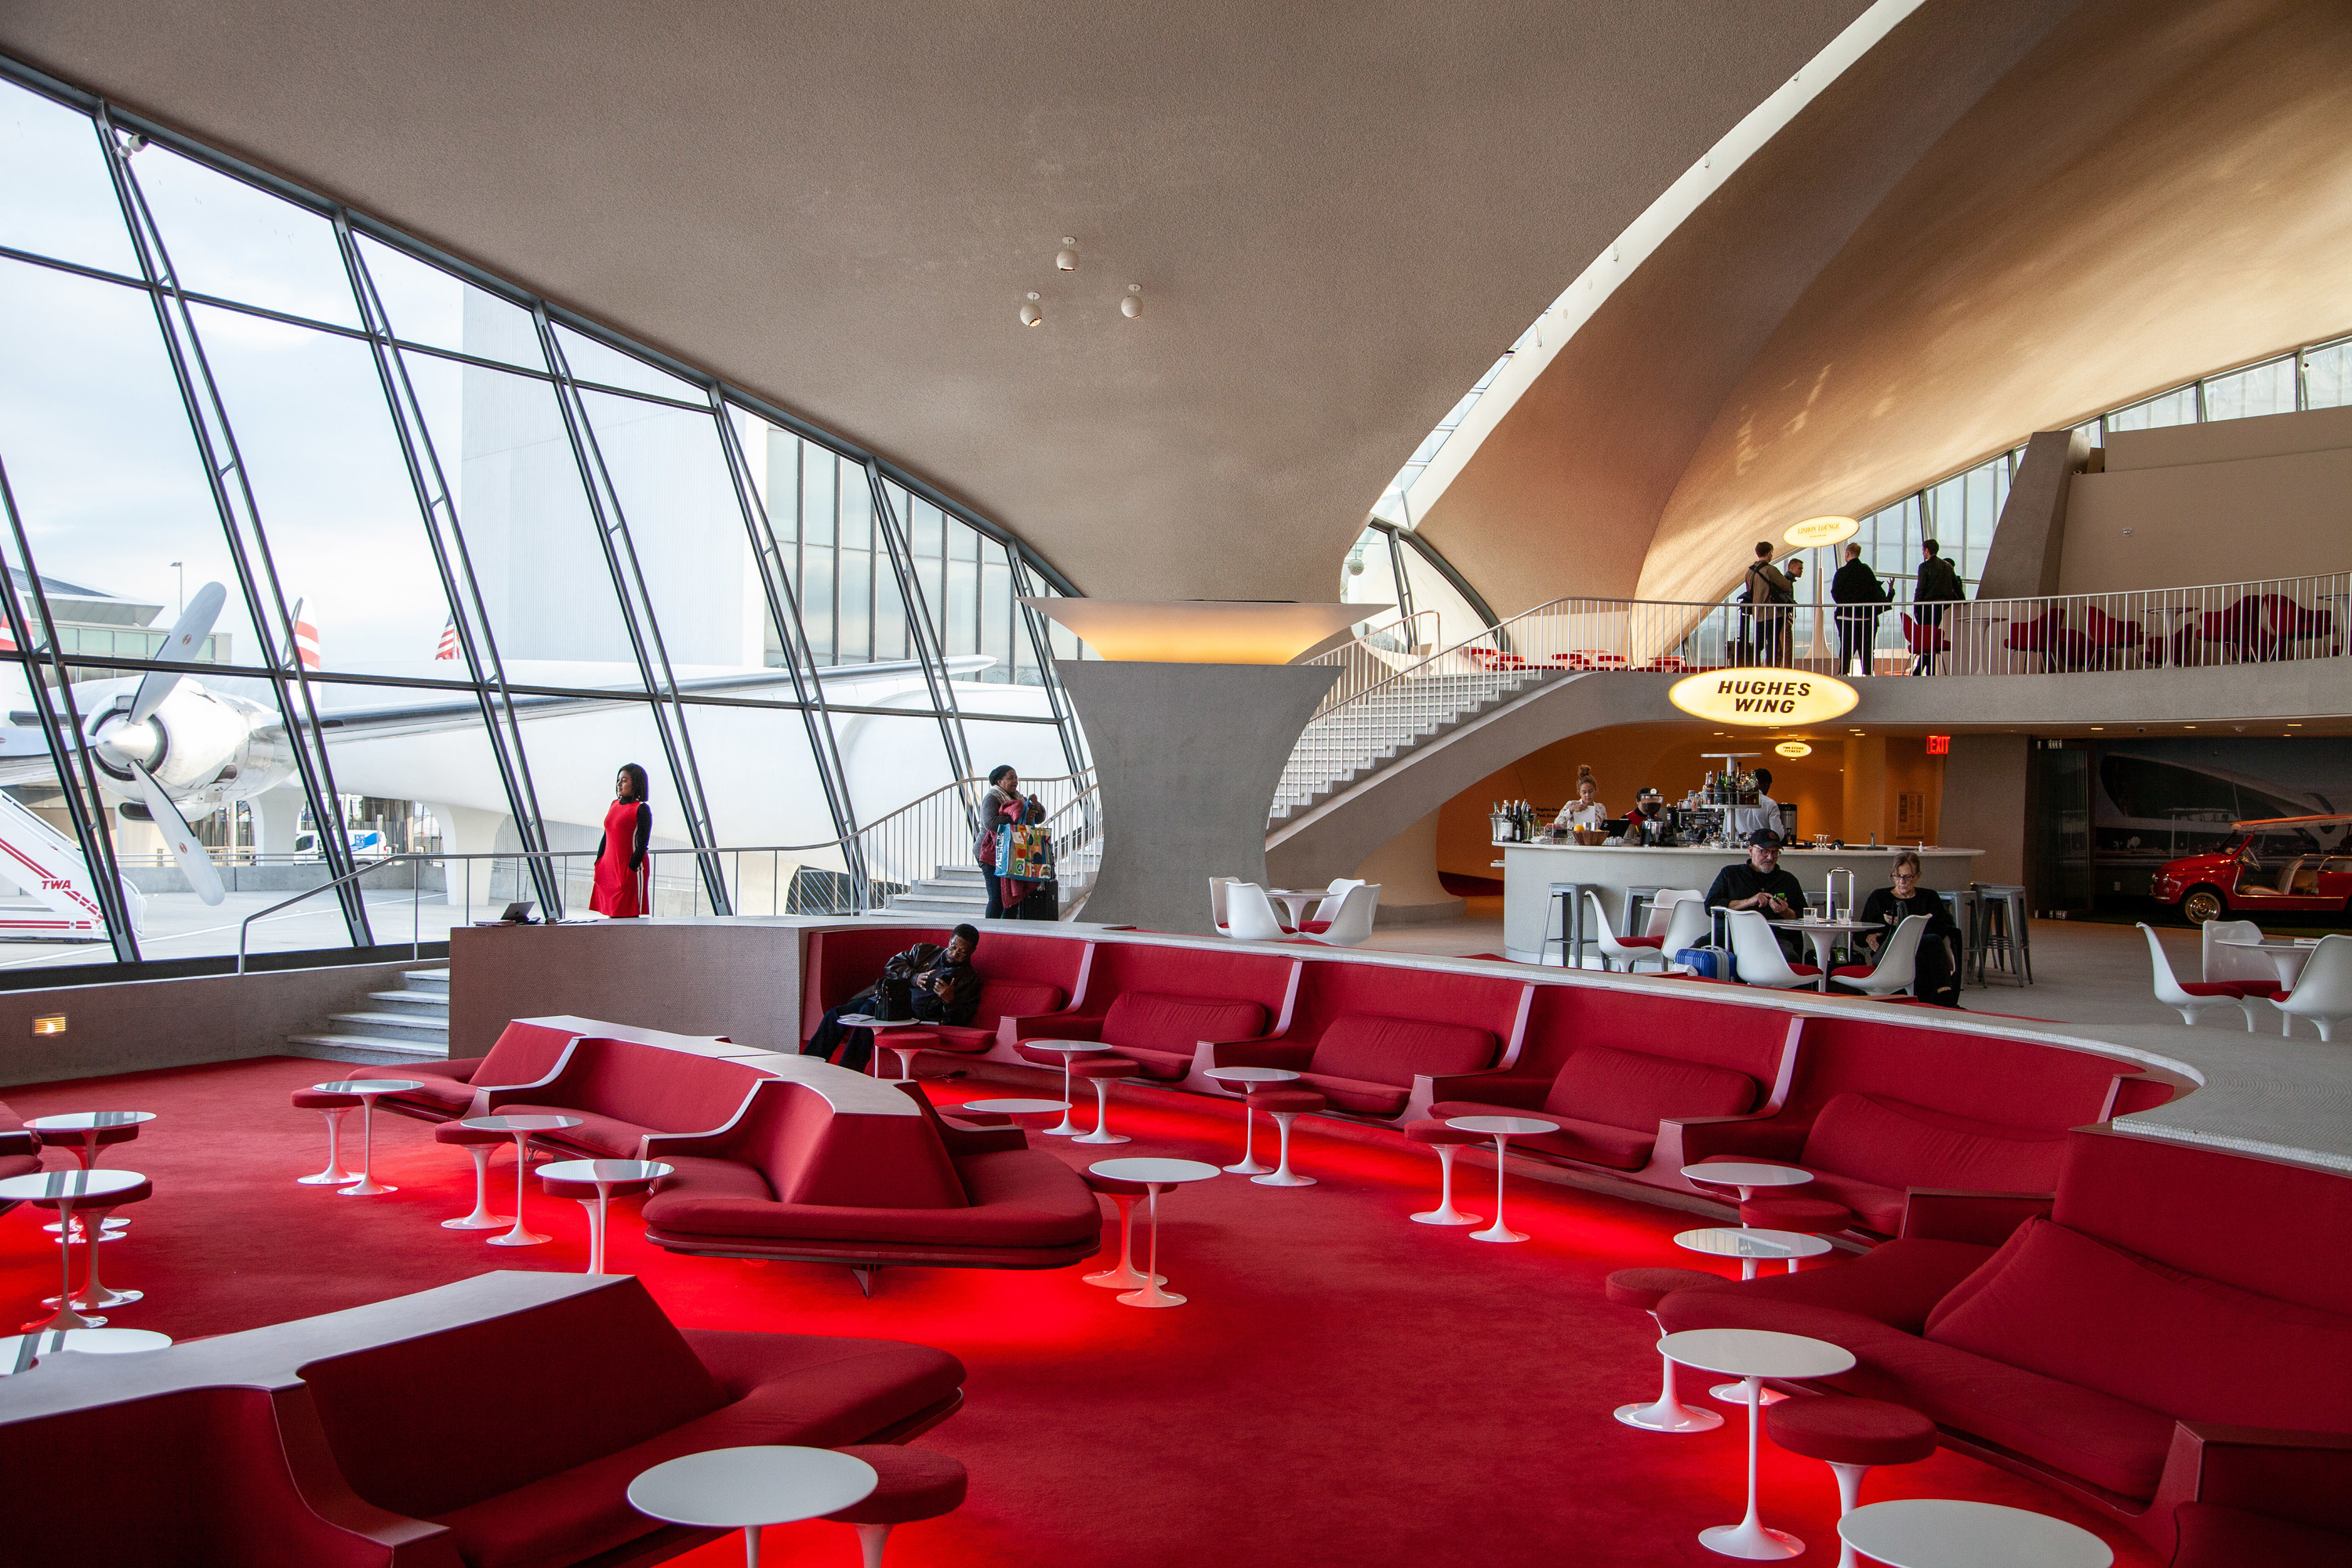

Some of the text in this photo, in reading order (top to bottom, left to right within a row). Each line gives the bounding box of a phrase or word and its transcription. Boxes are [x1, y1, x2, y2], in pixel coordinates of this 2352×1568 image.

[1818, 523, 1840, 532] LOUNGE
[1718, 681, 1811, 696] HUGHES
[1735, 699, 1795, 713] WING
[1929, 736, 1951, 753] EXIT
[996, 832, 1004, 869] Marshalls
[42, 880, 71, 890] TWA
